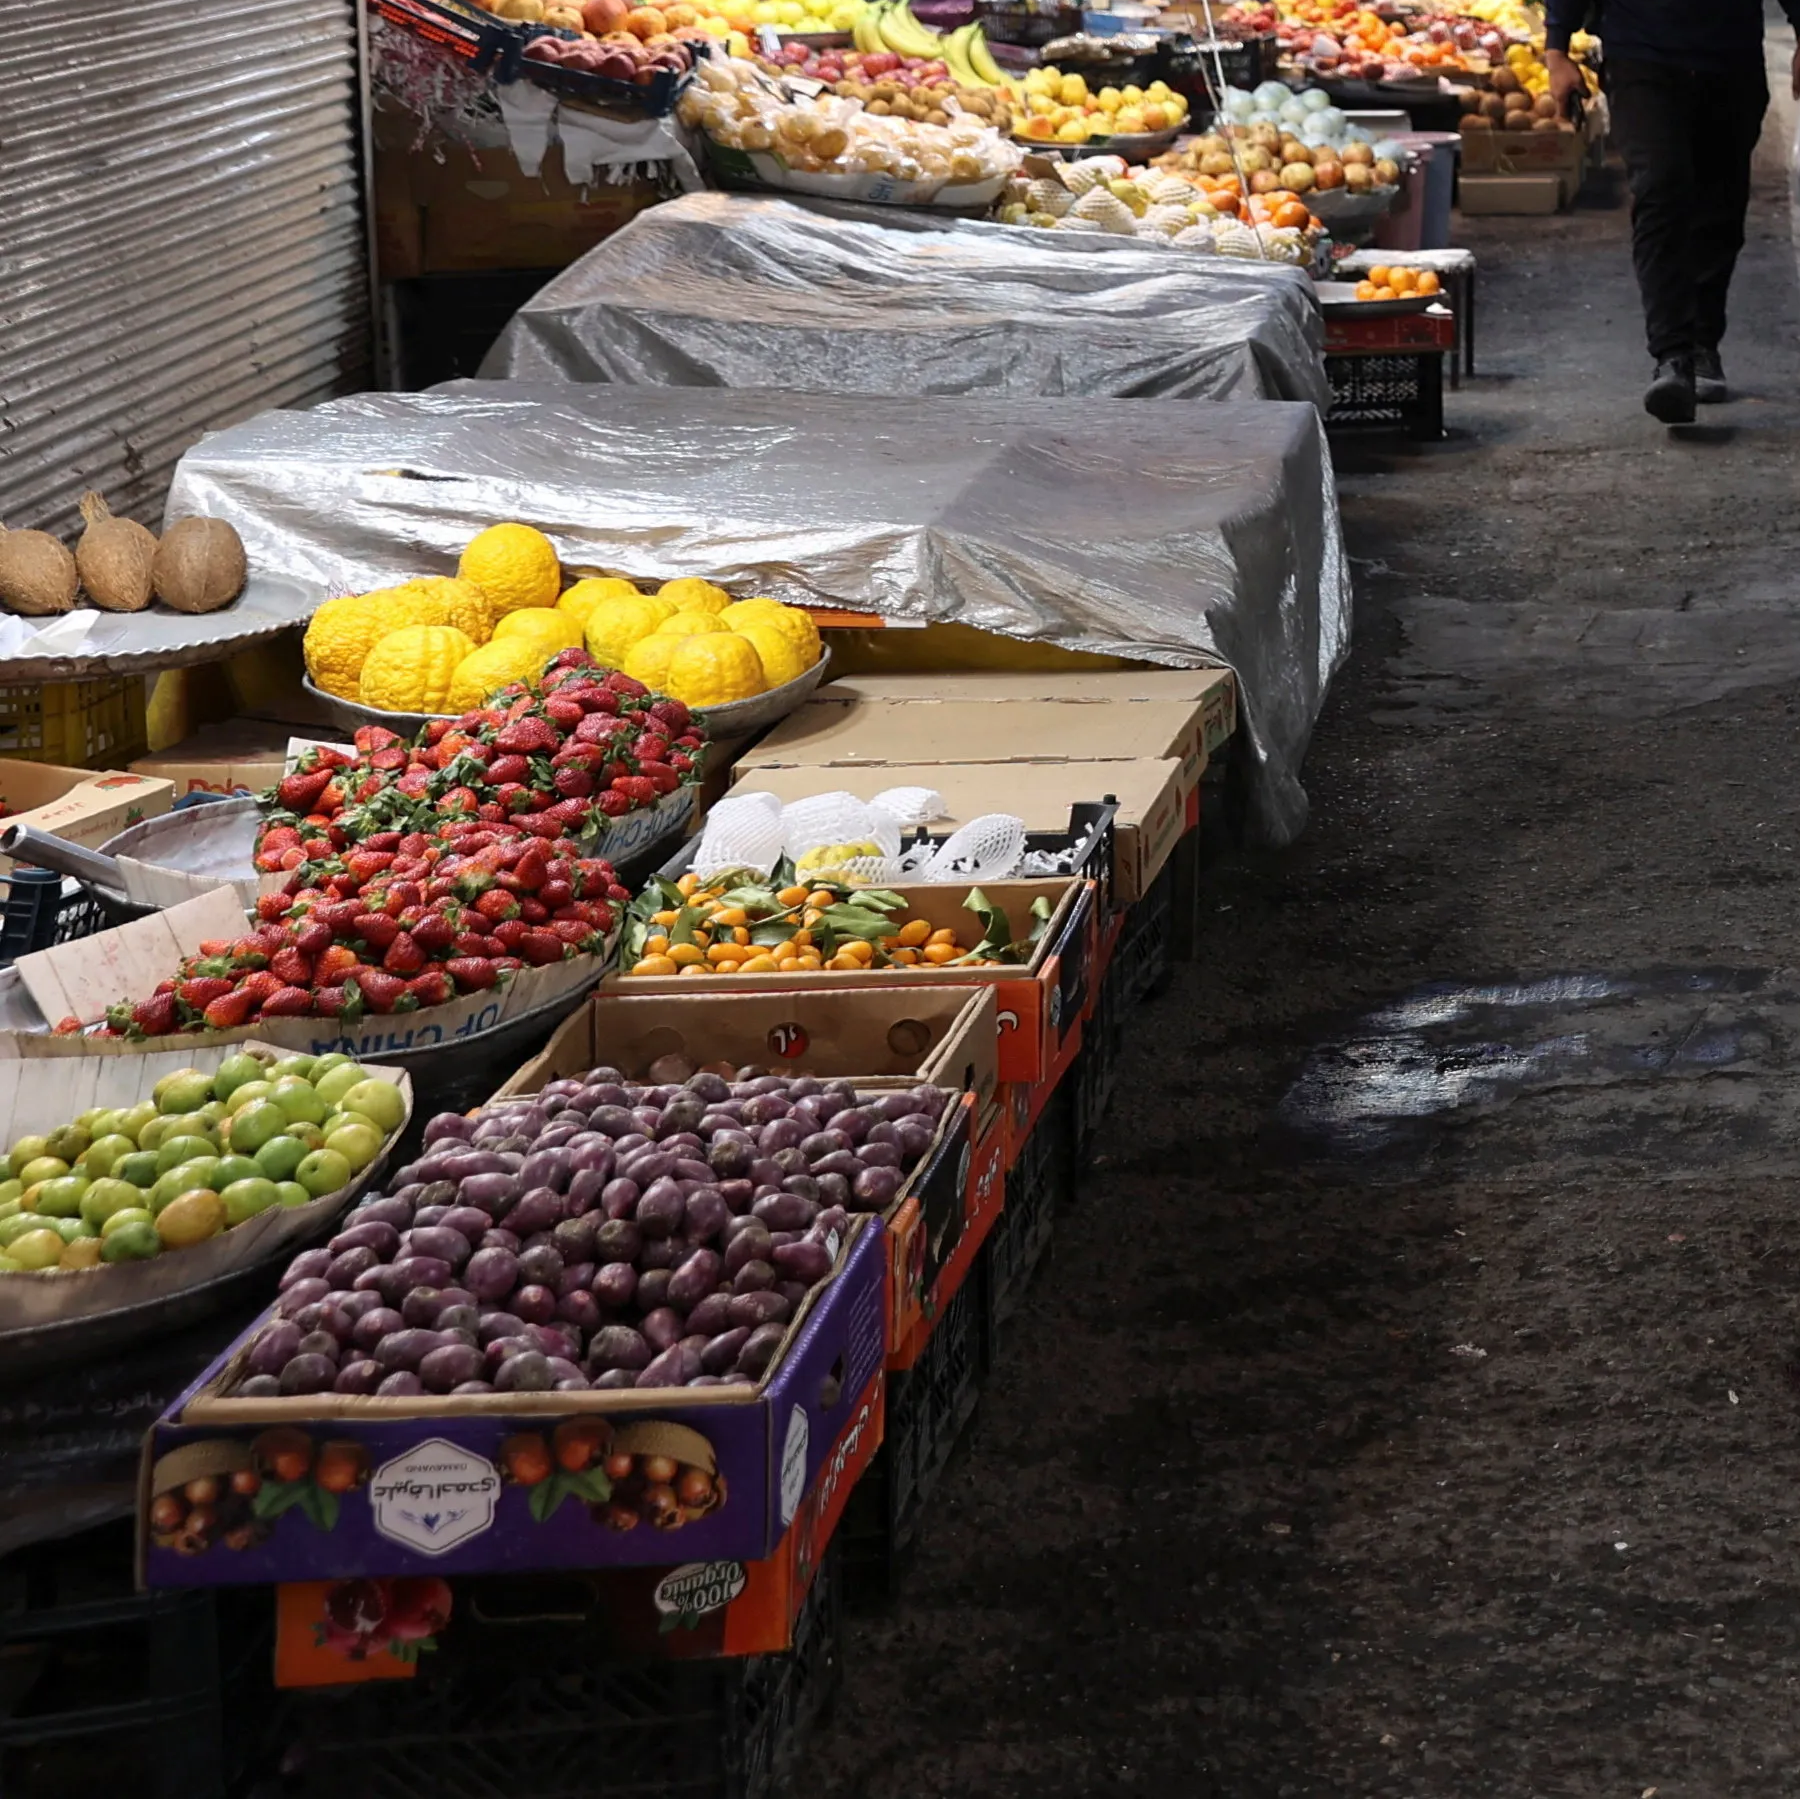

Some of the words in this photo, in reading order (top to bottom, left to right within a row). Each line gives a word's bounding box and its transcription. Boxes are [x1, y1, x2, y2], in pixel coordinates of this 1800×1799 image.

[455, 1003, 500, 1037] OF
[310, 1023, 443, 1058] CHINA
[374, 1478, 434, 1502] علیرضا
[436, 1476, 497, 1500] احمدی
[661, 1561, 742, 1600] Organic
[677, 1582, 731, 1615] 100%
